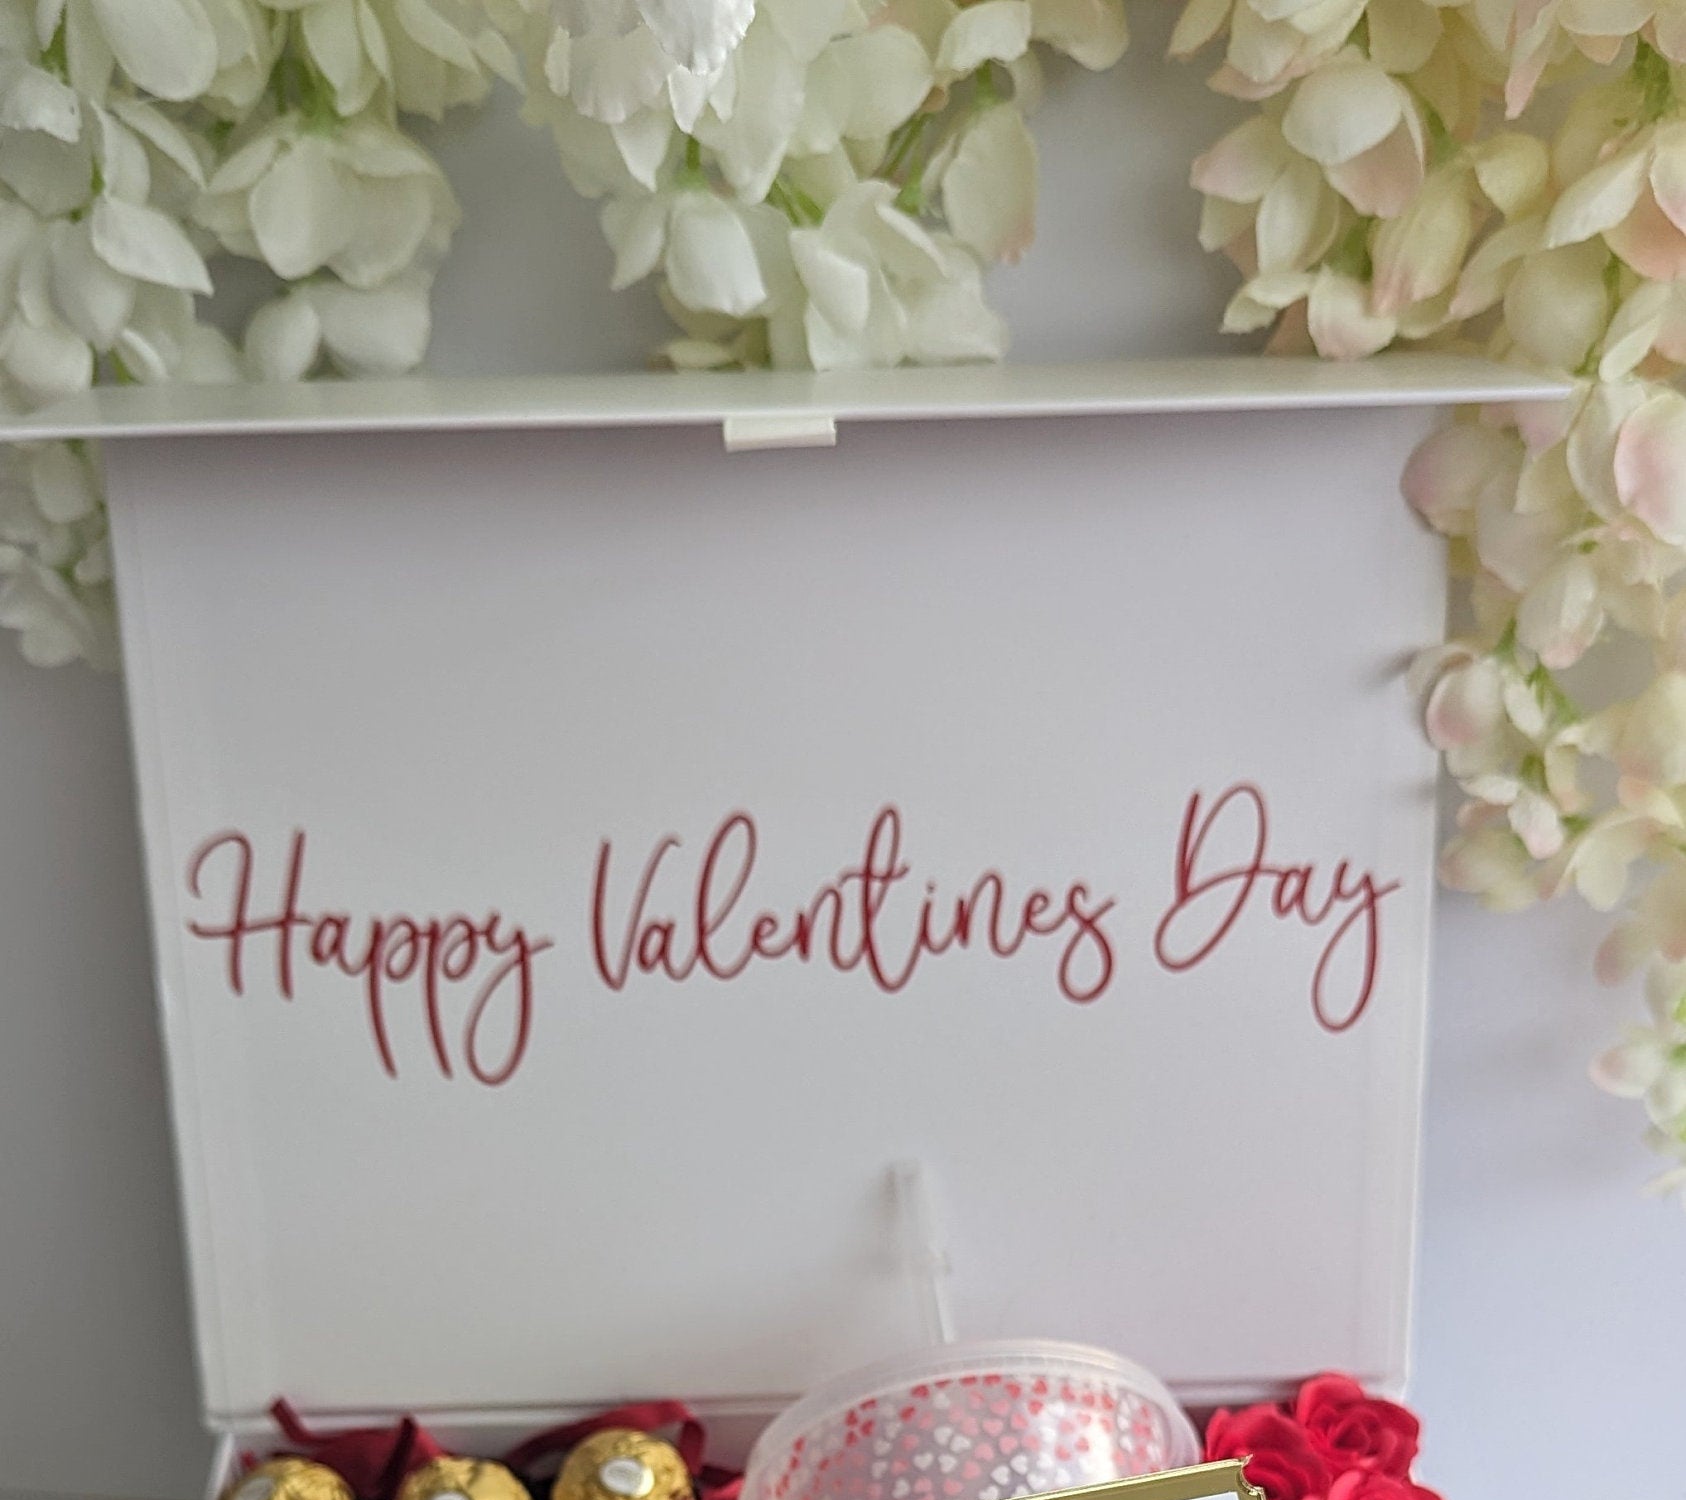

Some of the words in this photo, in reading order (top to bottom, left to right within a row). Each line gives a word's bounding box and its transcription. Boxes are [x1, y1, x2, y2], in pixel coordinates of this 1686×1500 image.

[187, 826, 555, 1087] Happy
[590, 803, 1117, 1003] Valentines
[1153, 780, 1402, 1034] Day
